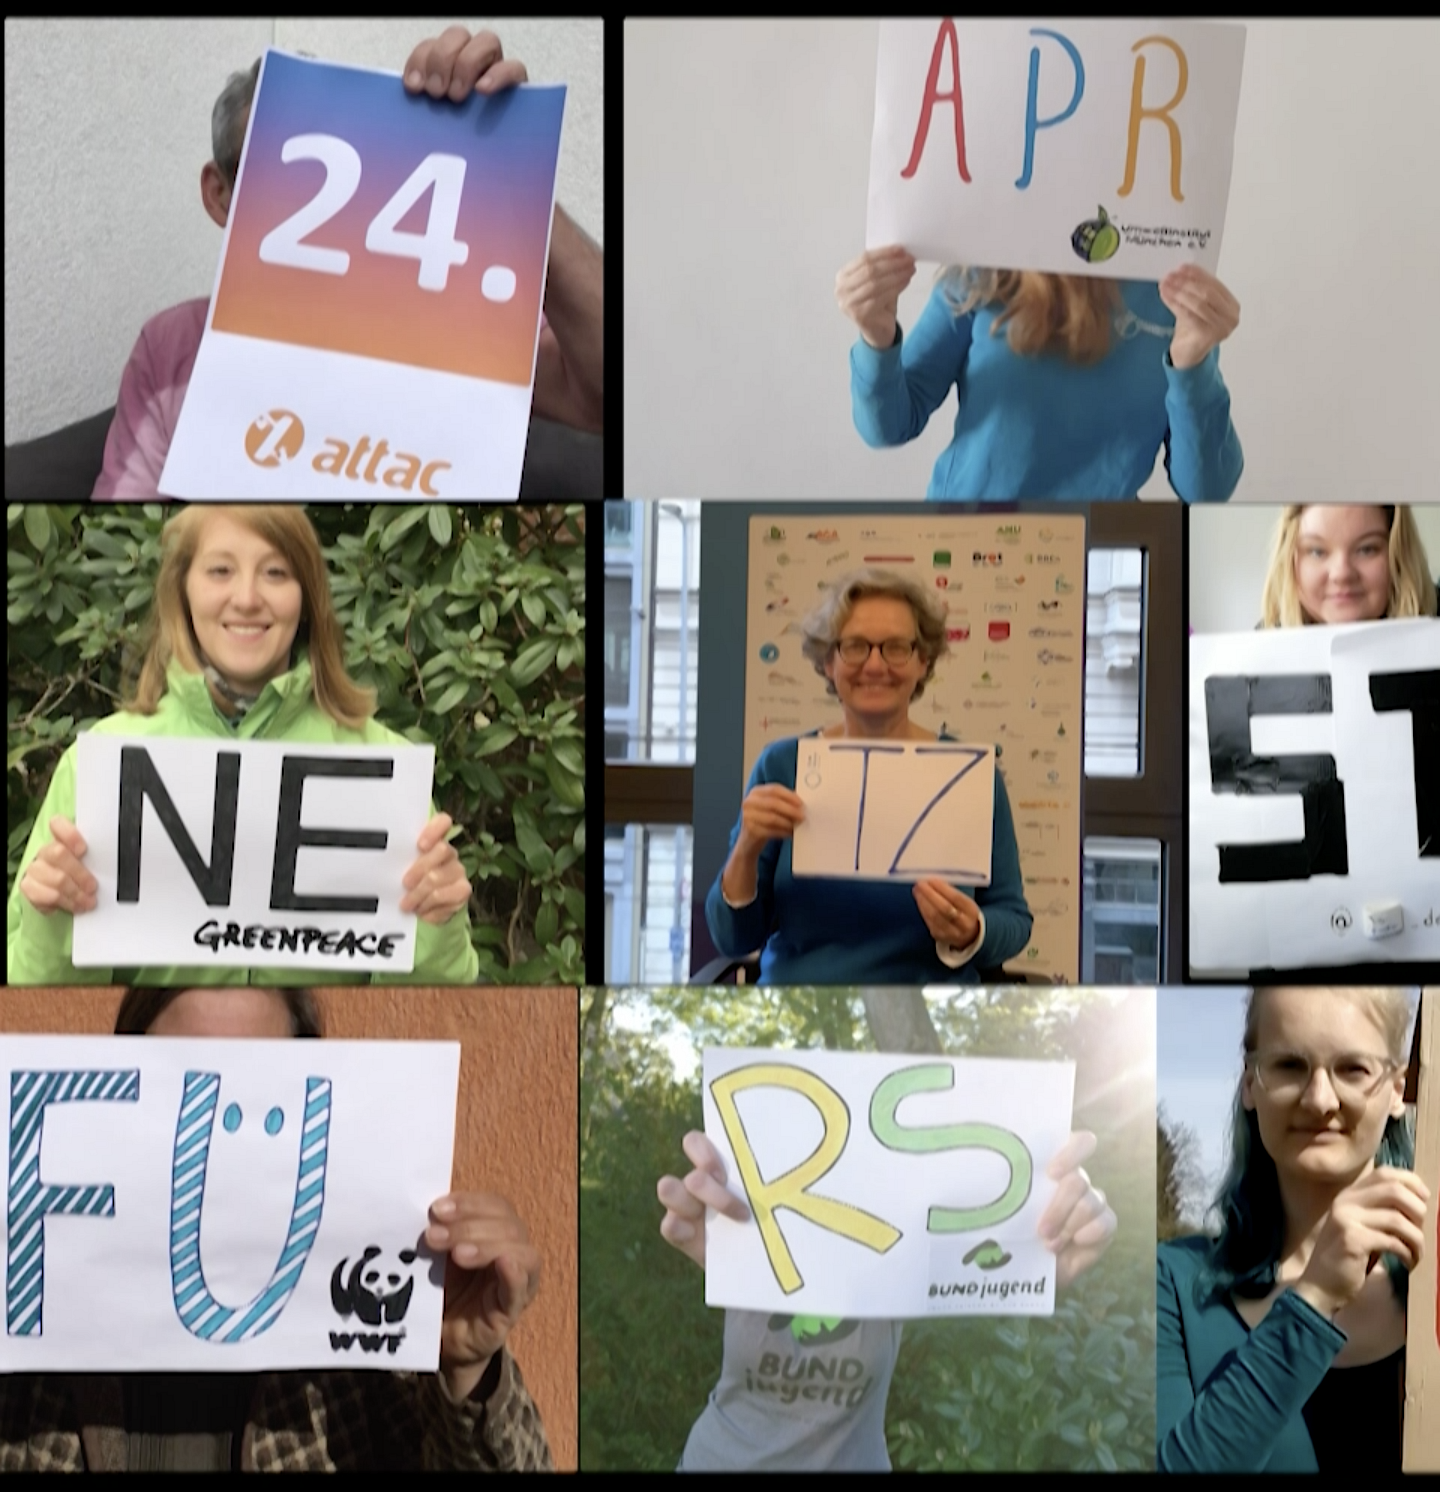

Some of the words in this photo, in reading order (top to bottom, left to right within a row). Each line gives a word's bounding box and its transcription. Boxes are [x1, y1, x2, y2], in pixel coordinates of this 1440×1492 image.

[900, 17, 1189, 202] APR
[258, 132, 518, 303] 24.
[311, 435, 453, 498] attac
[116, 745, 395, 914] NE
[828, 743, 990, 881] TZ
[193, 920, 405, 959] GREENPEACE
[7, 1068, 332, 1344] FÜ
[710, 1061, 1034, 1297] RS
[328, 1327, 407, 1355] WWF
[746, 1367, 873, 1408] jugend
[757, 1351, 864, 1383] BUND
